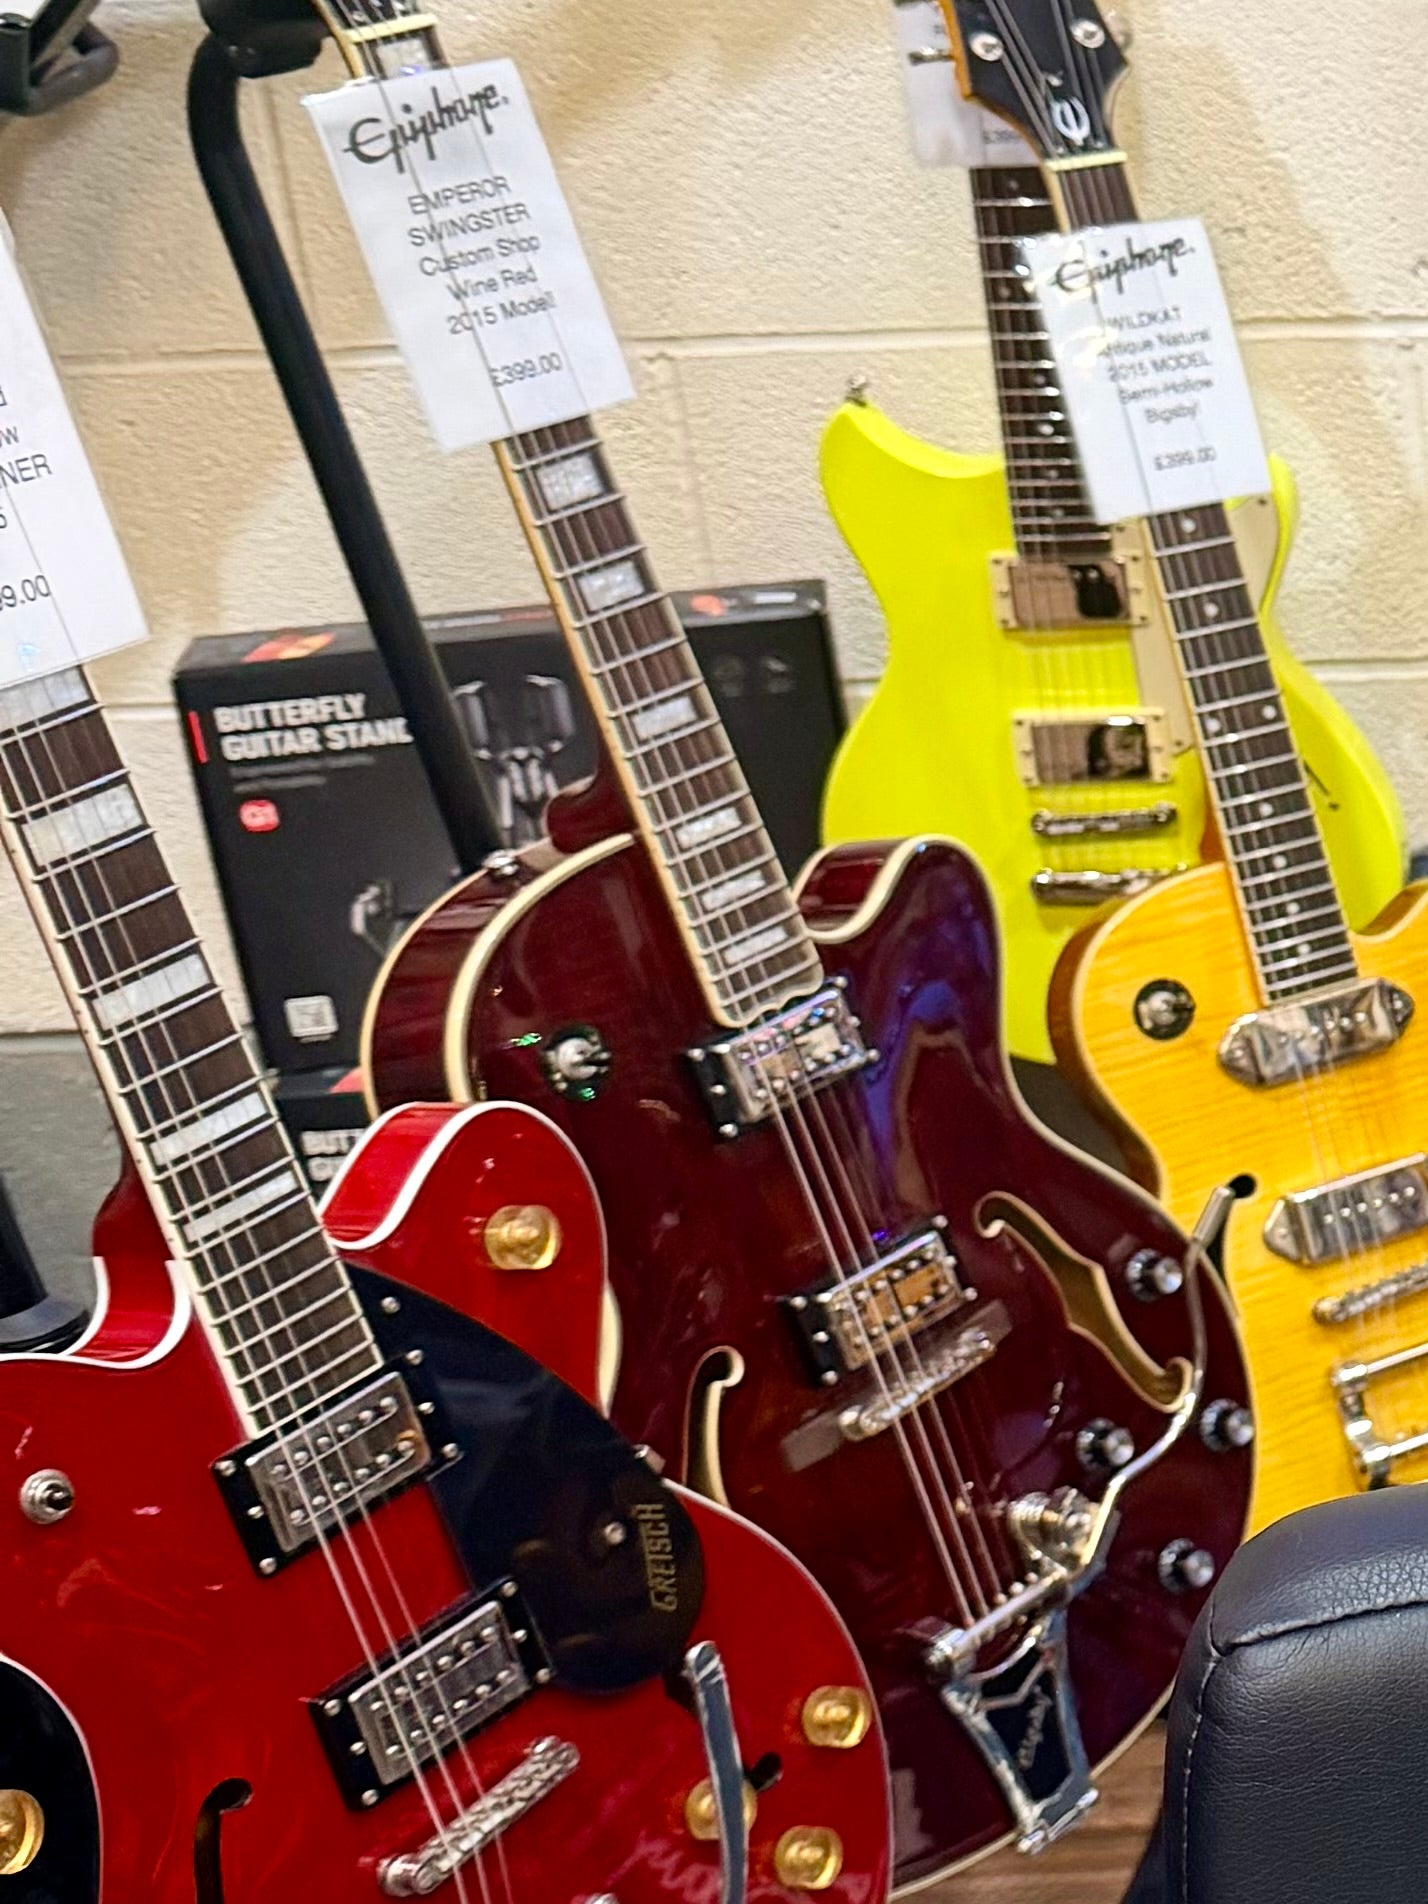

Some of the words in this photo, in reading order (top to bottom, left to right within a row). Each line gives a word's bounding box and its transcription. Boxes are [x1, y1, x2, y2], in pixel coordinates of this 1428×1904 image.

[407, 175, 512, 215] EMPEROR
[407, 202, 531, 247] SWINGSTER
[419, 242, 495, 276] Custom
[498, 232, 541, 262] Shop
[446, 274, 500, 303] Wine
[502, 266, 538, 291] Red
[446, 307, 498, 336] 2015
[213, 692, 366, 734] BUTTERFLY
[220, 726, 324, 761] GUITAR
